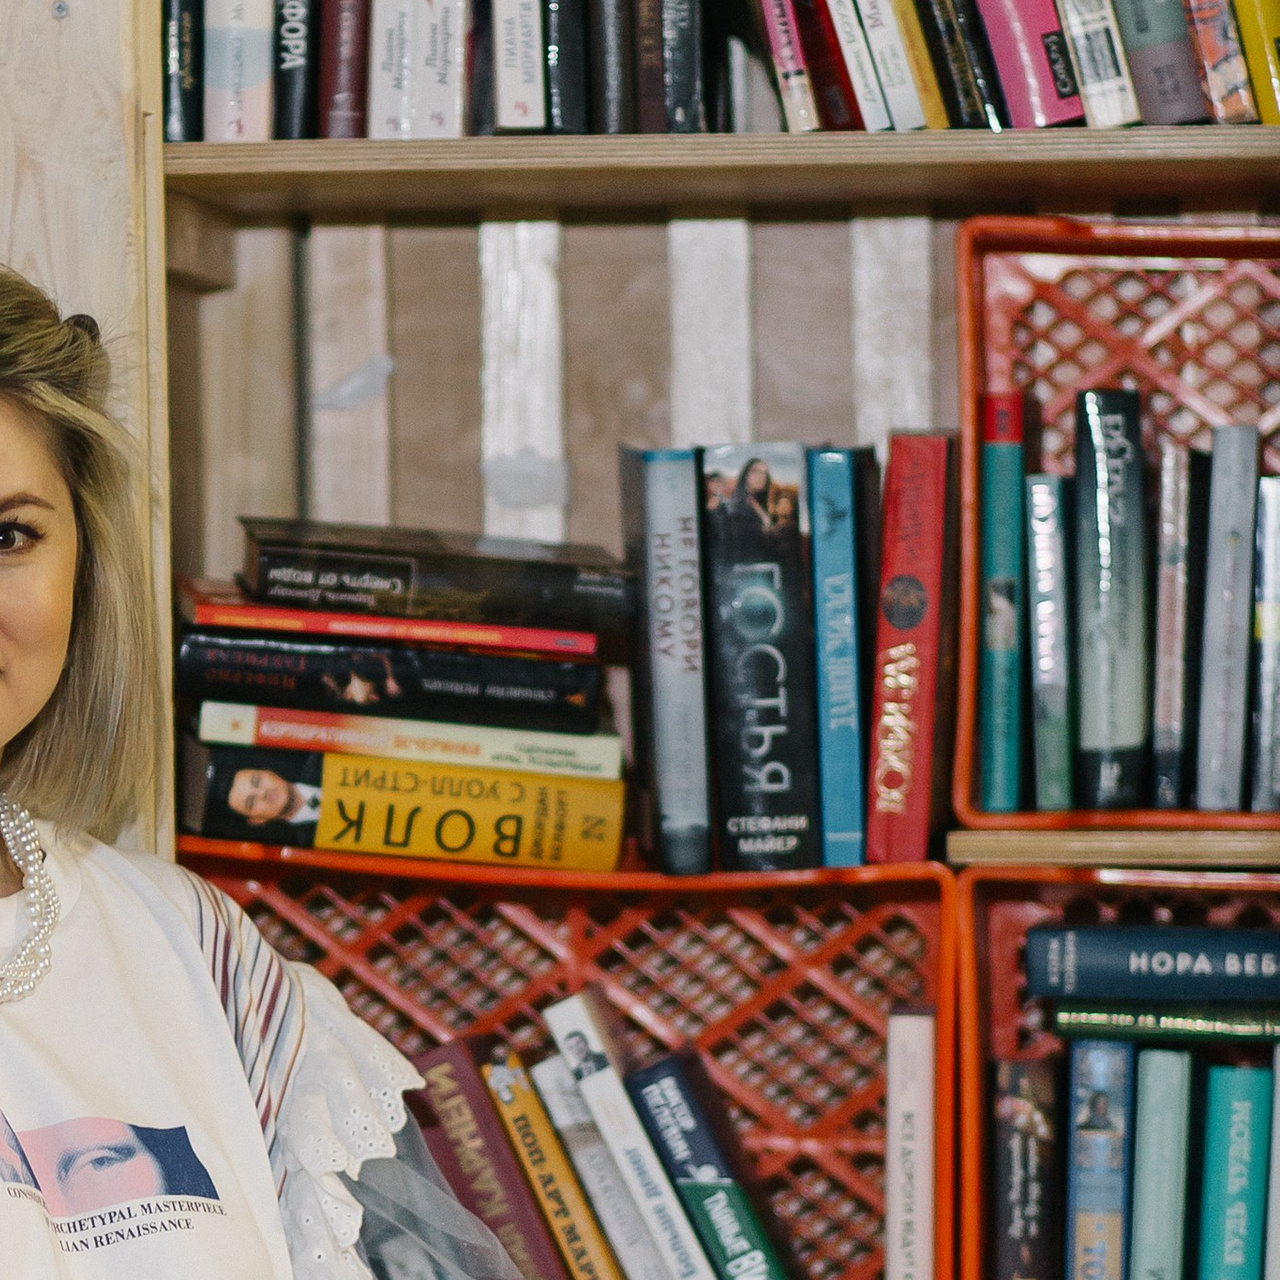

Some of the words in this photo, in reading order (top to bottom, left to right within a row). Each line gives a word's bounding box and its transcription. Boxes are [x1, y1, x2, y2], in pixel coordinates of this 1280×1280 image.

[503, 17, 517, 68] ЛИАНА
[520, 1, 534, 83] МОРИАРТИ
[676, 515, 694, 547] НЕ
[268, 565, 313, 584] воды
[318, 571, 337, 586] от
[338, 570, 402, 594] Смерть
[649, 532, 676, 658] НИКОМУ
[676, 559, 701, 674] ГОВОРИ
[730, 559, 794, 797] ГОСТЬЯ
[335, 766, 500, 800] УОЛЛ-СТРИТ
[508, 781, 526, 804] С
[332, 798, 523, 858] ВОЛК
[1128, 949, 1212, 976] НОРА
[419, 1061, 511, 1220] КАРНЕГИ
[640, 1080, 694, 1166] ПЕЛЕВИН
[140, 1201, 227, 1217] MASTERPIECE
[700, 1188, 752, 1259] ТАЙНЫЕ
[60, 1238, 90, 1253] LIAN
[94, 1218, 194, 1249] RENAISSANCE
